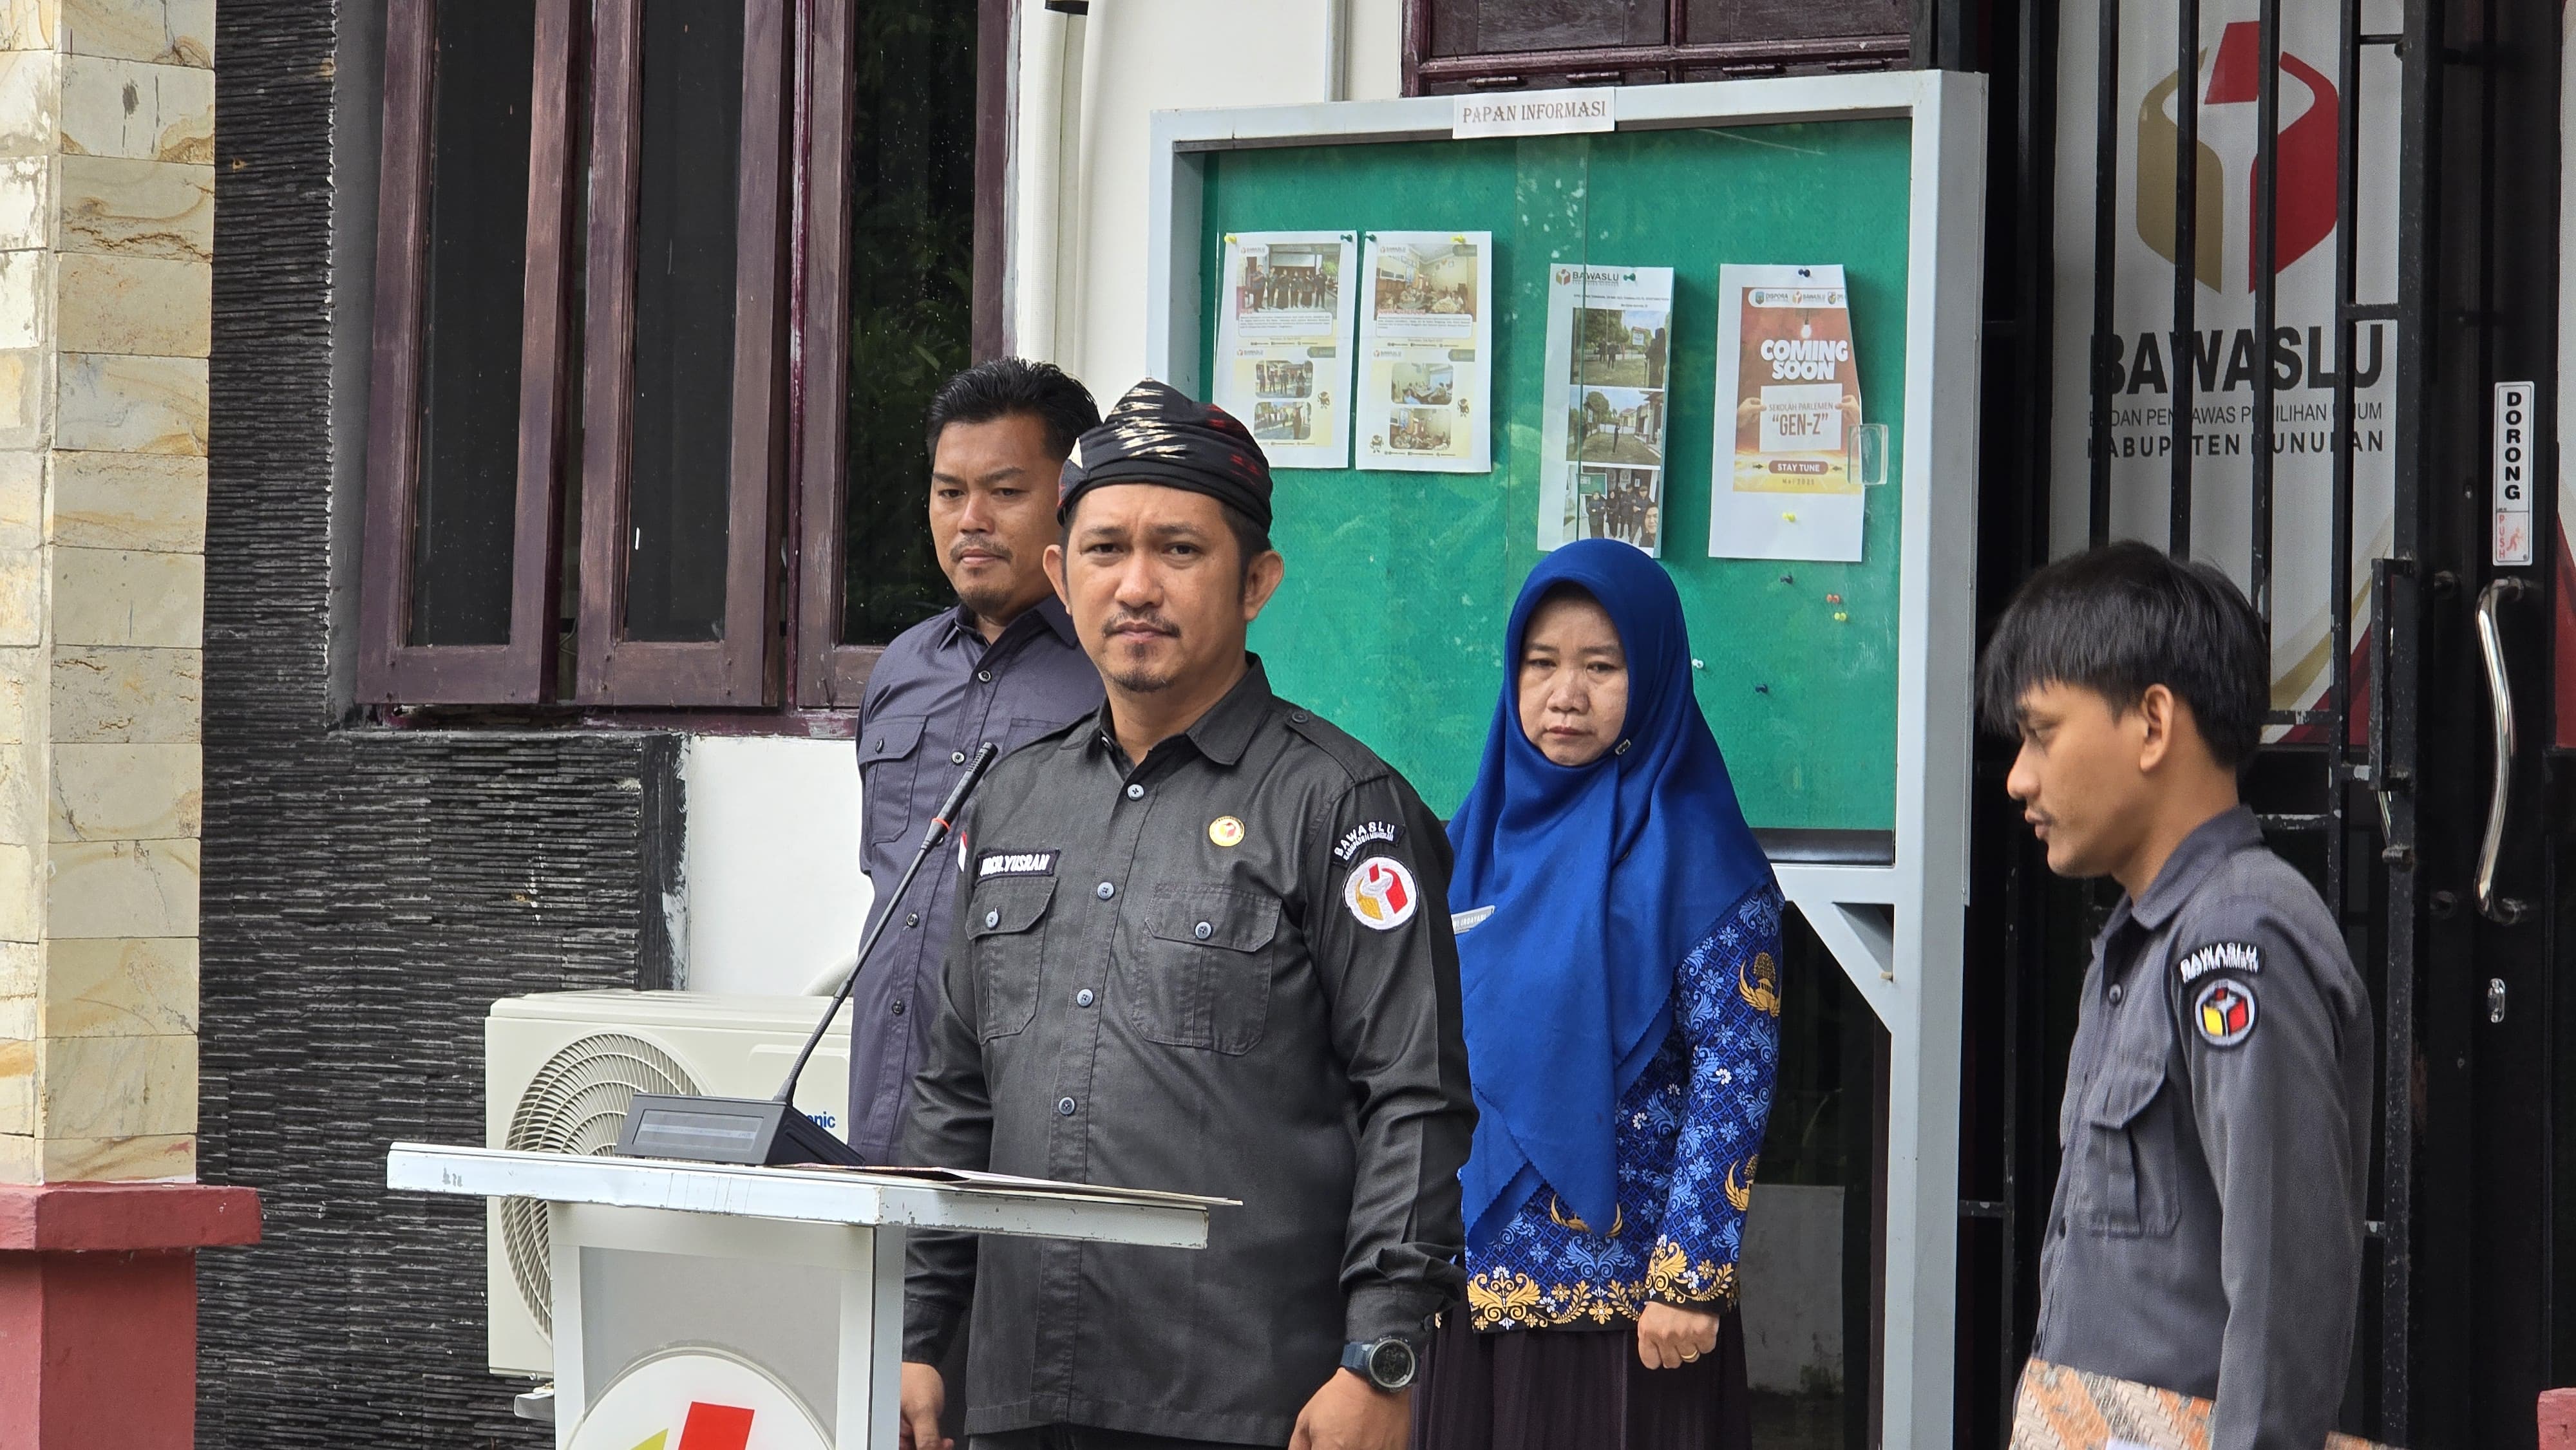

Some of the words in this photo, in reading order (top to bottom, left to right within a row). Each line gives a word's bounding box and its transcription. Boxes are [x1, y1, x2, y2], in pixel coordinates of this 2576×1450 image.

[1463, 105, 1516, 123] PAPAN
[1521, 100, 1605, 120] INFORMASI
[1572, 271, 1619, 281] BAWASLU
[1761, 339, 1848, 362] COMING
[1772, 360, 1835, 381] SOON
[1769, 402, 1797, 411] SEKOLAH
[1799, 401, 1833, 411] PARLEMEN
[2089, 408, 2141, 427] DAN
[2146, 406, 2236, 426] PENAWAS
[2240, 403, 2327, 422] PILIHAN
[2505, 391, 2522, 500] DORONG
[1777, 463, 1797, 471] STAY
[1799, 464, 1820, 472] TUNE
[1334, 821, 1395, 857] BAWASLU
